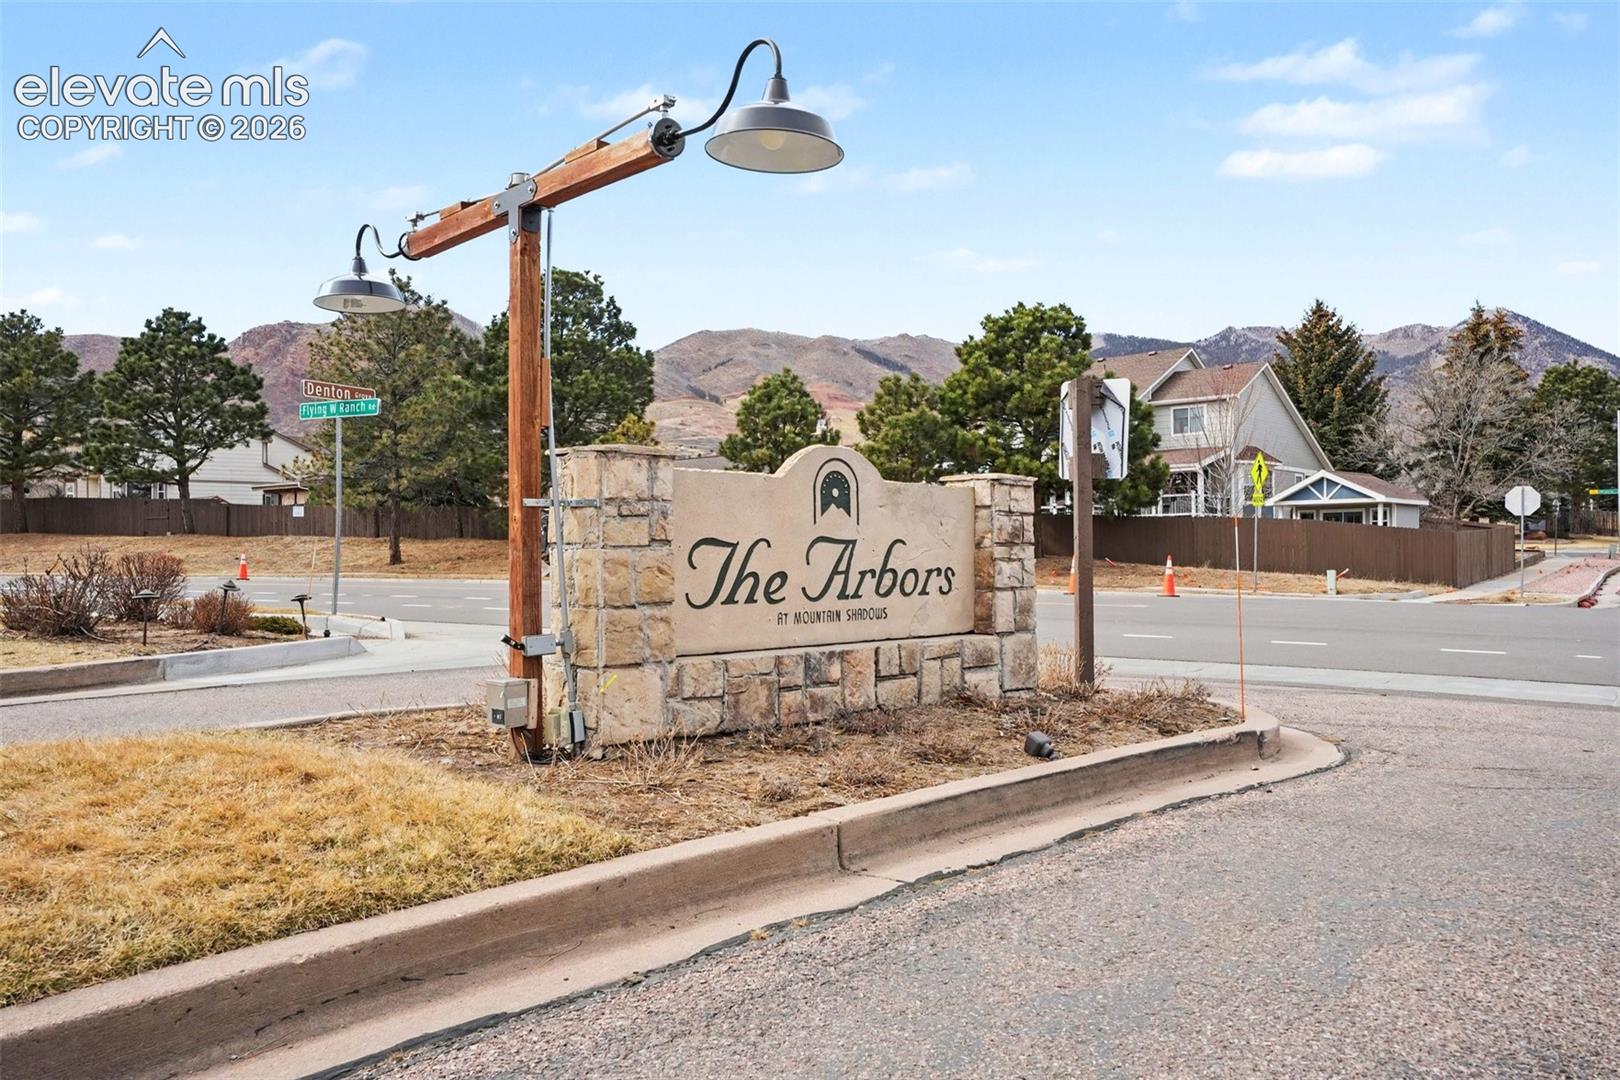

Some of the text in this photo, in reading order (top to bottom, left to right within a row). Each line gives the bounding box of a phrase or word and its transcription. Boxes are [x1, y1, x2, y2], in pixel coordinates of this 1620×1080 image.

[307, 382, 350, 400] Denton
[302, 403, 327, 418] Flying
[329, 403, 337, 414] W
[339, 401, 366, 413] Ranch
[685, 535, 956, 610] The Arbors
[777, 607, 888, 626] AT MOUNTAIN SHADOWS
